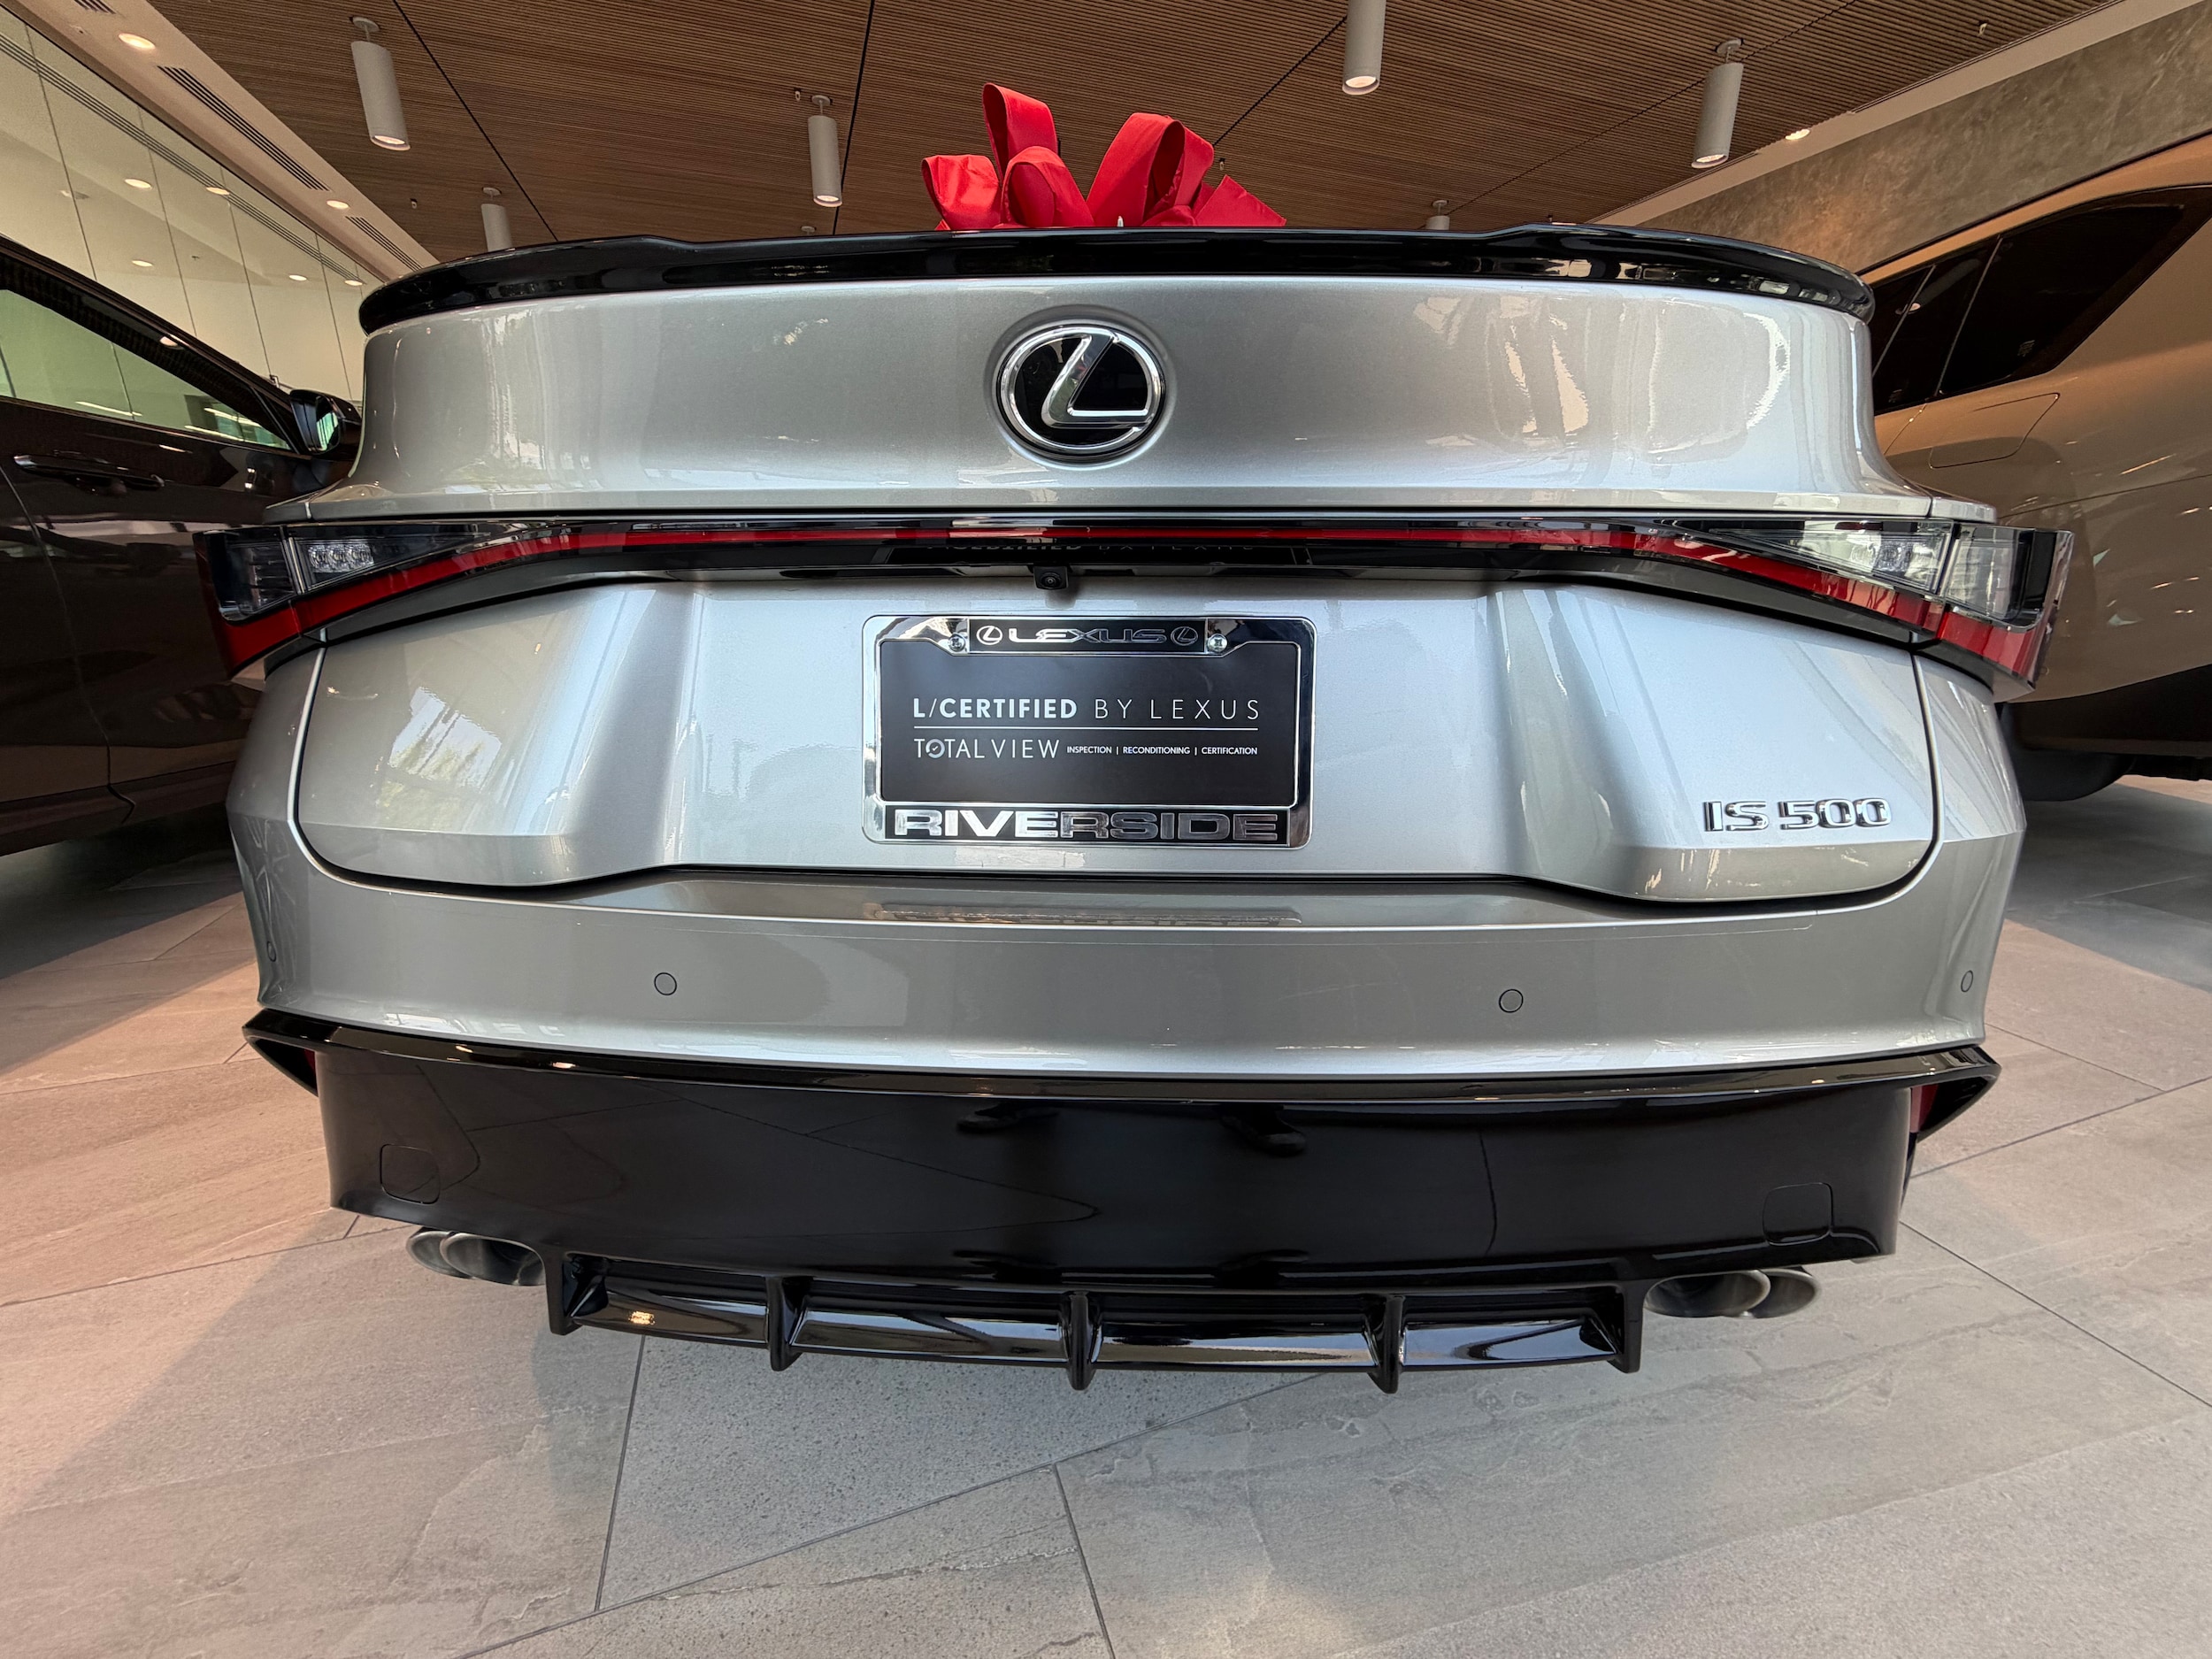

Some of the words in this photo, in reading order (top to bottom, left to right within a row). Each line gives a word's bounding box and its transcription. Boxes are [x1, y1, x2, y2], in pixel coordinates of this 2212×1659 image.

[1009, 628, 1167, 644] LEXUS
[913, 697, 1078, 718] L/CERTIFIED
[1094, 699, 1133, 719] BY
[1150, 699, 1260, 720] LEXUS
[914, 738, 986, 759] TOTAL
[991, 739, 1060, 759] VIEW
[1123, 746, 1191, 755] RECONDITIONING
[1202, 747, 1258, 756] CERTIFICATION
[894, 809, 1279, 841] RIVERSIDE
[1703, 800, 1770, 833] IS
[1778, 797, 1893, 830] 500
